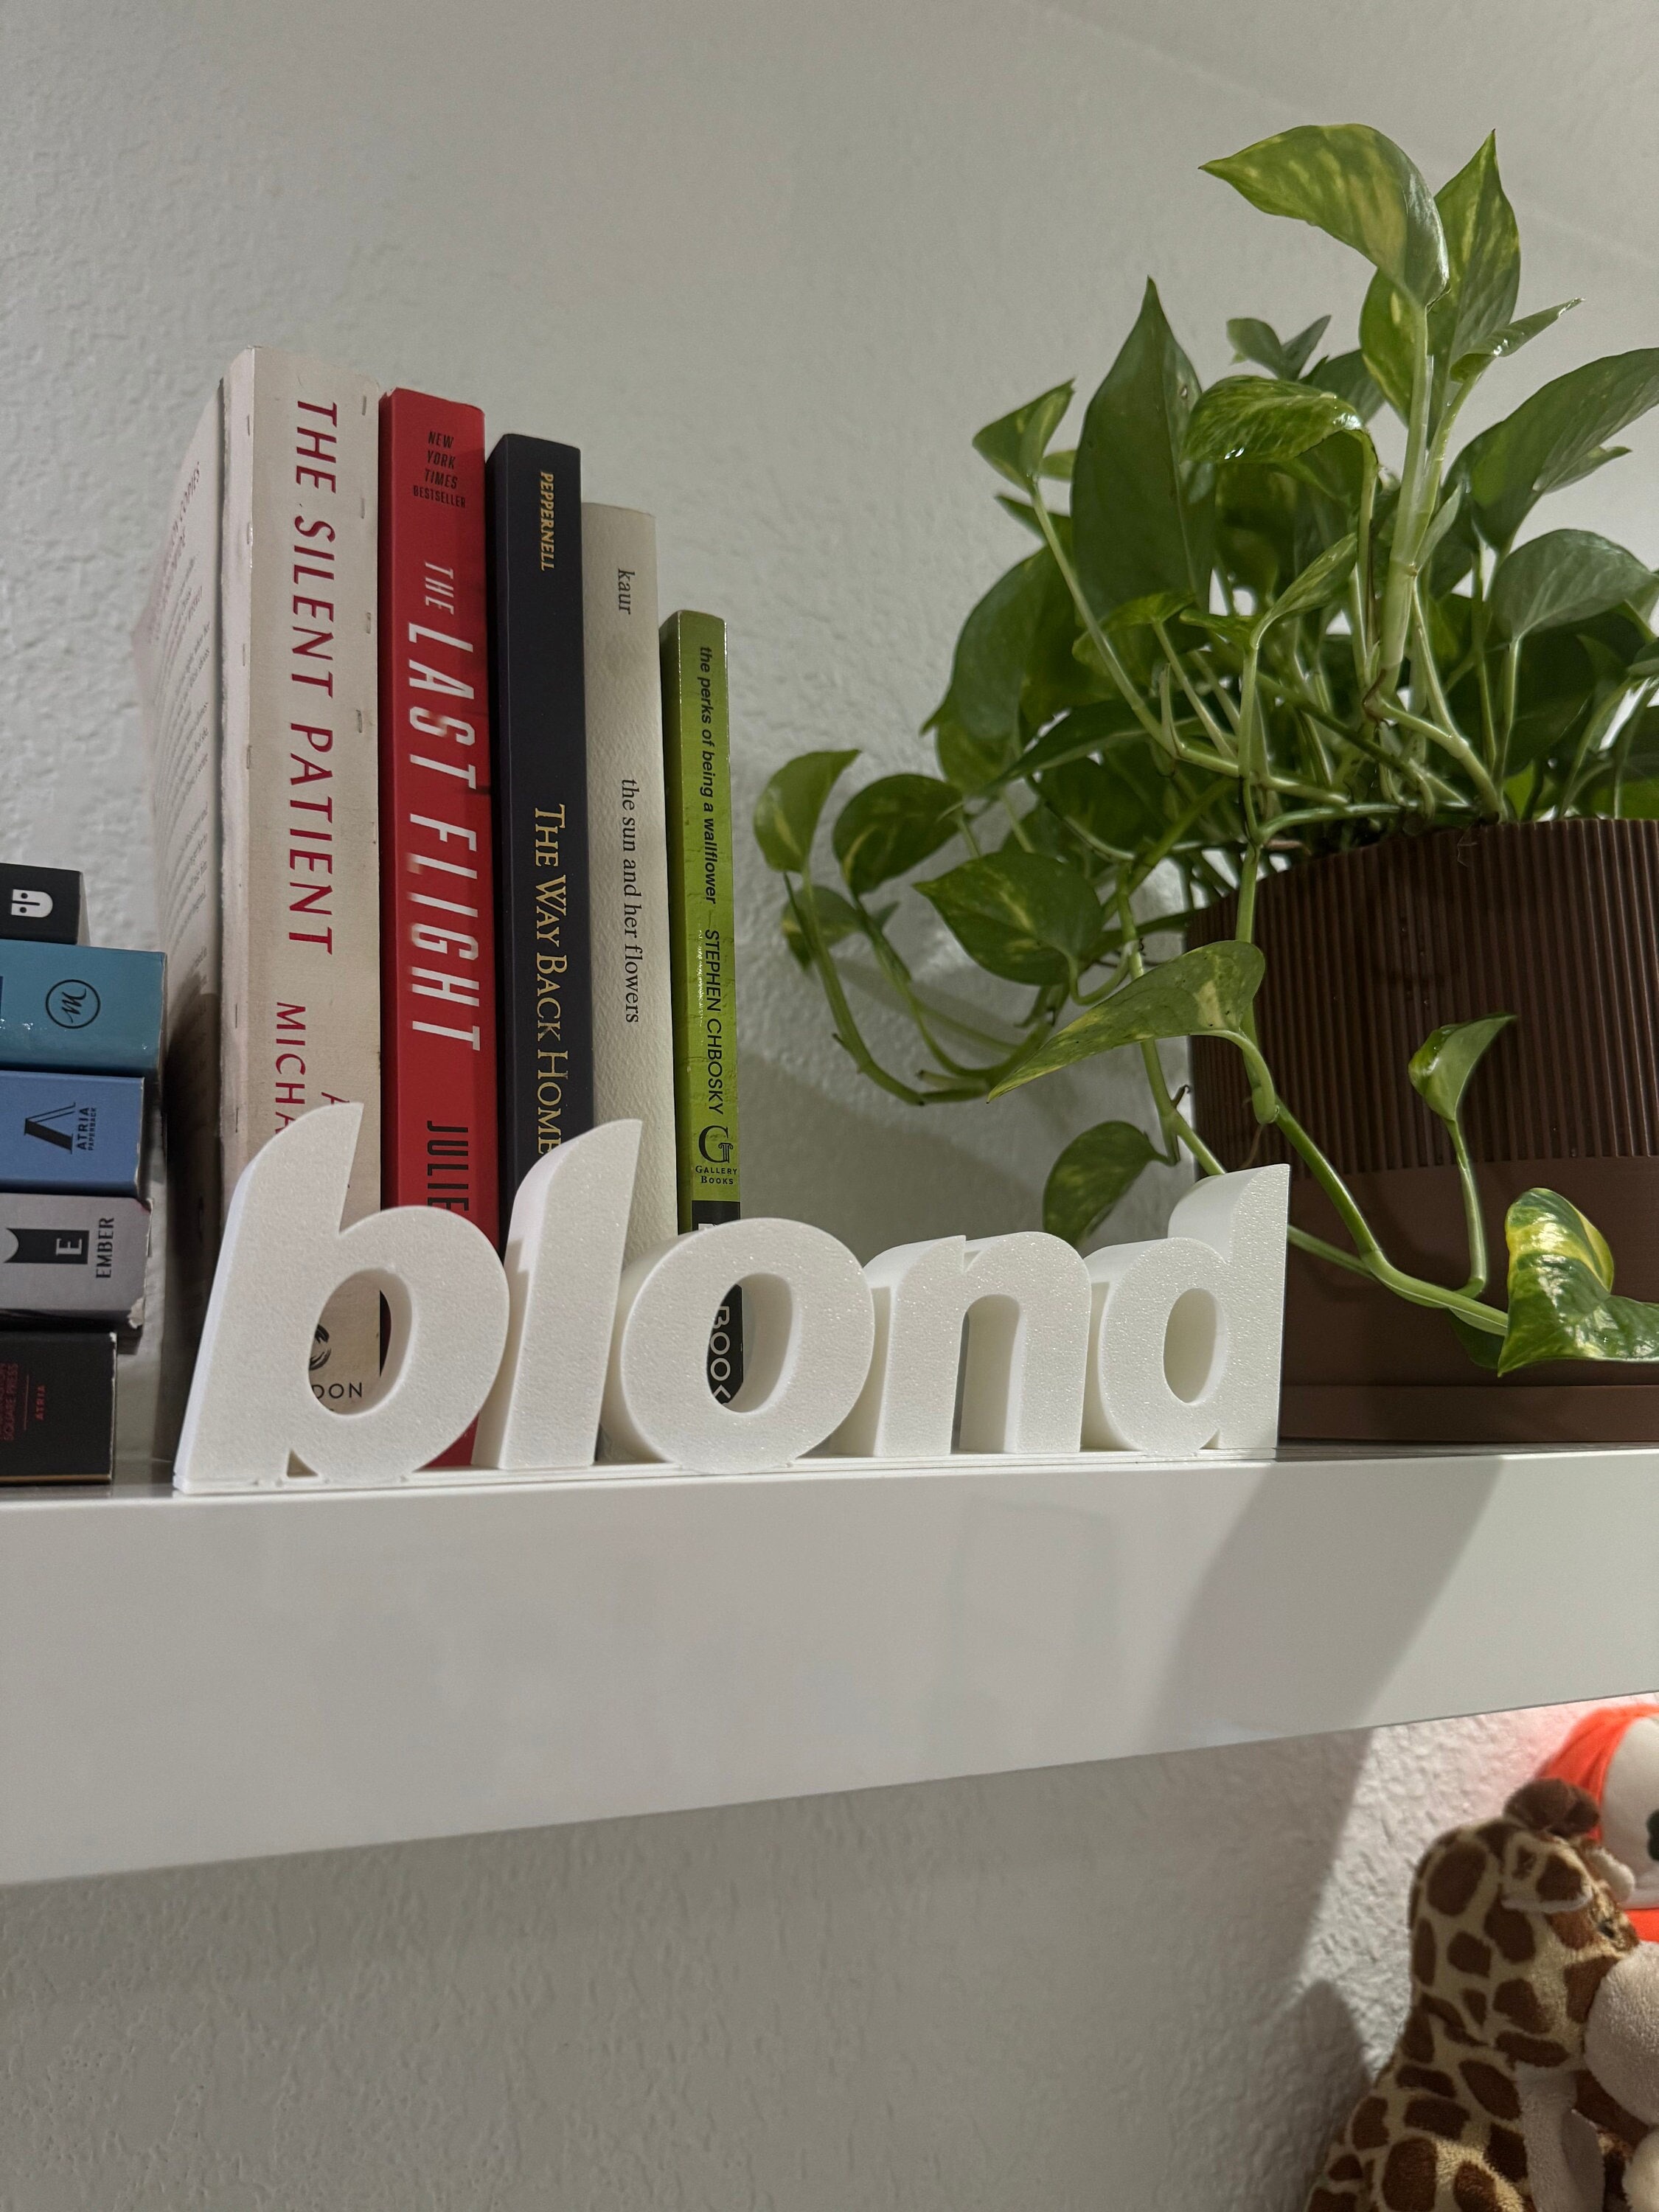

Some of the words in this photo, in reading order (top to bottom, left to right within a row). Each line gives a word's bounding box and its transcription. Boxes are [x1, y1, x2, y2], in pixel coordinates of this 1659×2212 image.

[296, 401, 338, 493] THE
[427, 450, 456, 470] YORK
[428, 431, 454, 449] NEW
[413, 485, 466, 508] BESTSELLER
[425, 468, 458, 490] TIMES
[540, 472, 555, 571] PEPPERNELL
[291, 515, 336, 698] SILENT
[425, 561, 454, 615] THE
[617, 568, 636, 615] kaur
[700, 647, 712, 672] the
[408, 622, 476, 790] LAST
[698, 677, 714, 723] perks
[702, 729, 715, 747] of
[622, 779, 636, 811] the
[700, 750, 714, 799] being
[703, 803, 714, 812] a
[289, 723, 333, 956] PATIENT
[535, 804, 566, 867] THE
[623, 816, 636, 852] sun
[624, 859, 641, 896] and
[704, 818, 718, 904] wallflower
[407, 813, 481, 1051] FLIGHT
[535, 874, 567, 947] WAY
[625, 902, 642, 938] her
[625, 944, 643, 1023] flowers
[706, 929, 721, 1012] STEPHEN
[537, 954, 568, 1041] BACK
[707, 1018, 725, 1115] CHBOSKY
[538, 1050, 568, 1155] HOME
[76, 1107, 89, 1150] ATRIA
[427, 1121, 469, 1211] JULIE
[695, 1165, 737, 1175] GALLERY
[701, 1176, 734, 1185] BOOKS
[96, 1217, 114, 1279] EMBER
[173, 1102, 1291, 1494] blond
[35, 1385, 46, 1421] ATRIA
